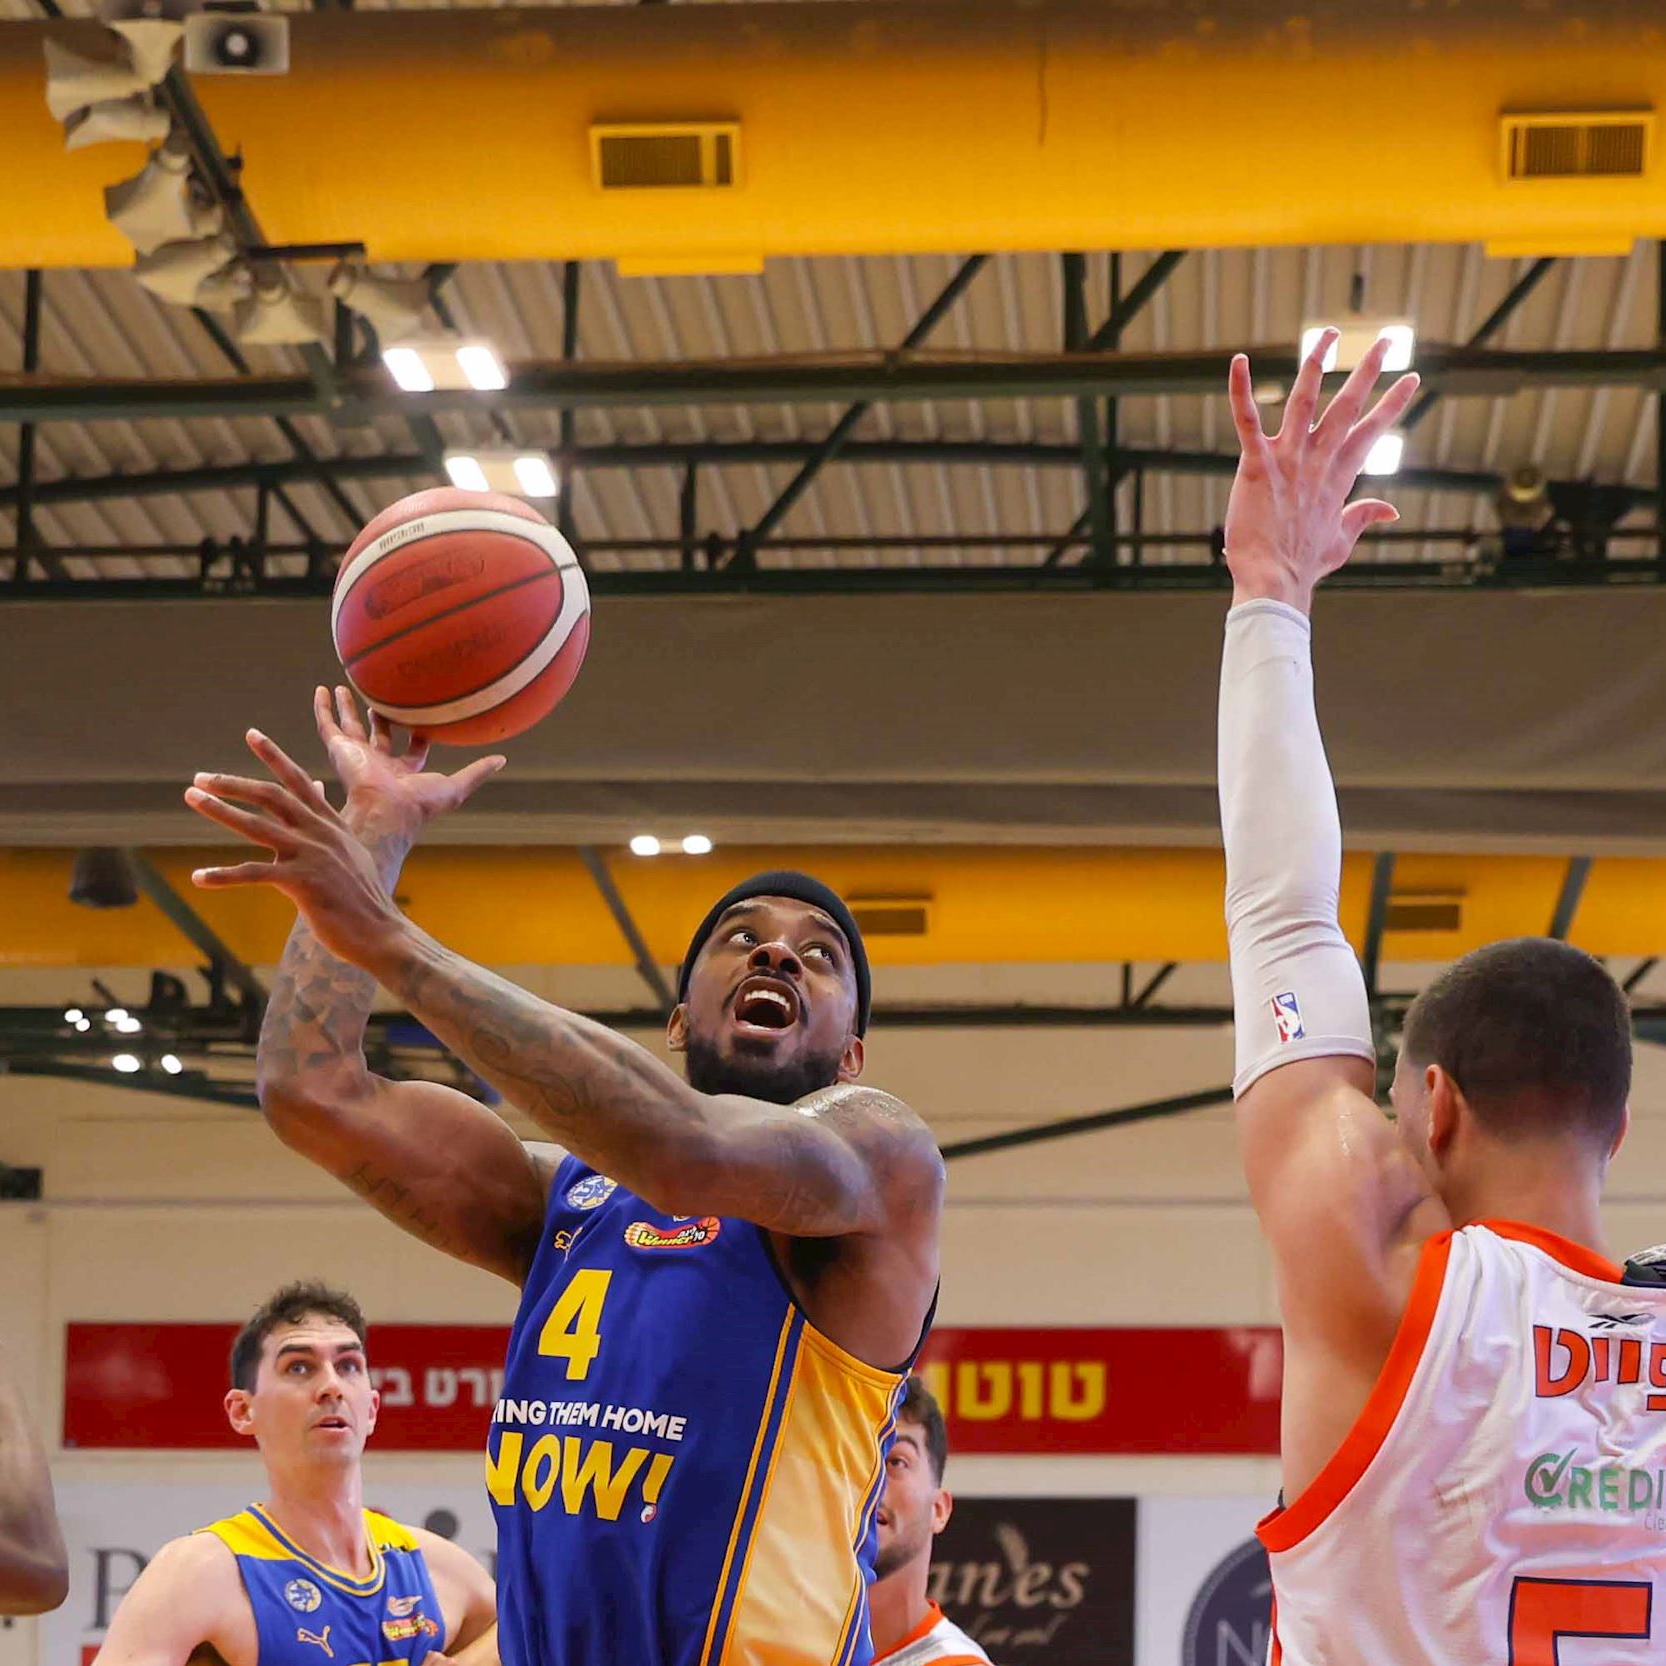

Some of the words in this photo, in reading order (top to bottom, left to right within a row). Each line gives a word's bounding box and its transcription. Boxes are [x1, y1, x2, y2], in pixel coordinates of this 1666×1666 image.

[638, 1231, 692, 1246] Winner
[538, 1269, 613, 1381] 4
[491, 1399, 547, 1425] ING
[548, 1401, 601, 1428] THEM
[600, 1405, 687, 1441] HOME
[485, 1431, 676, 1523] NOW!
